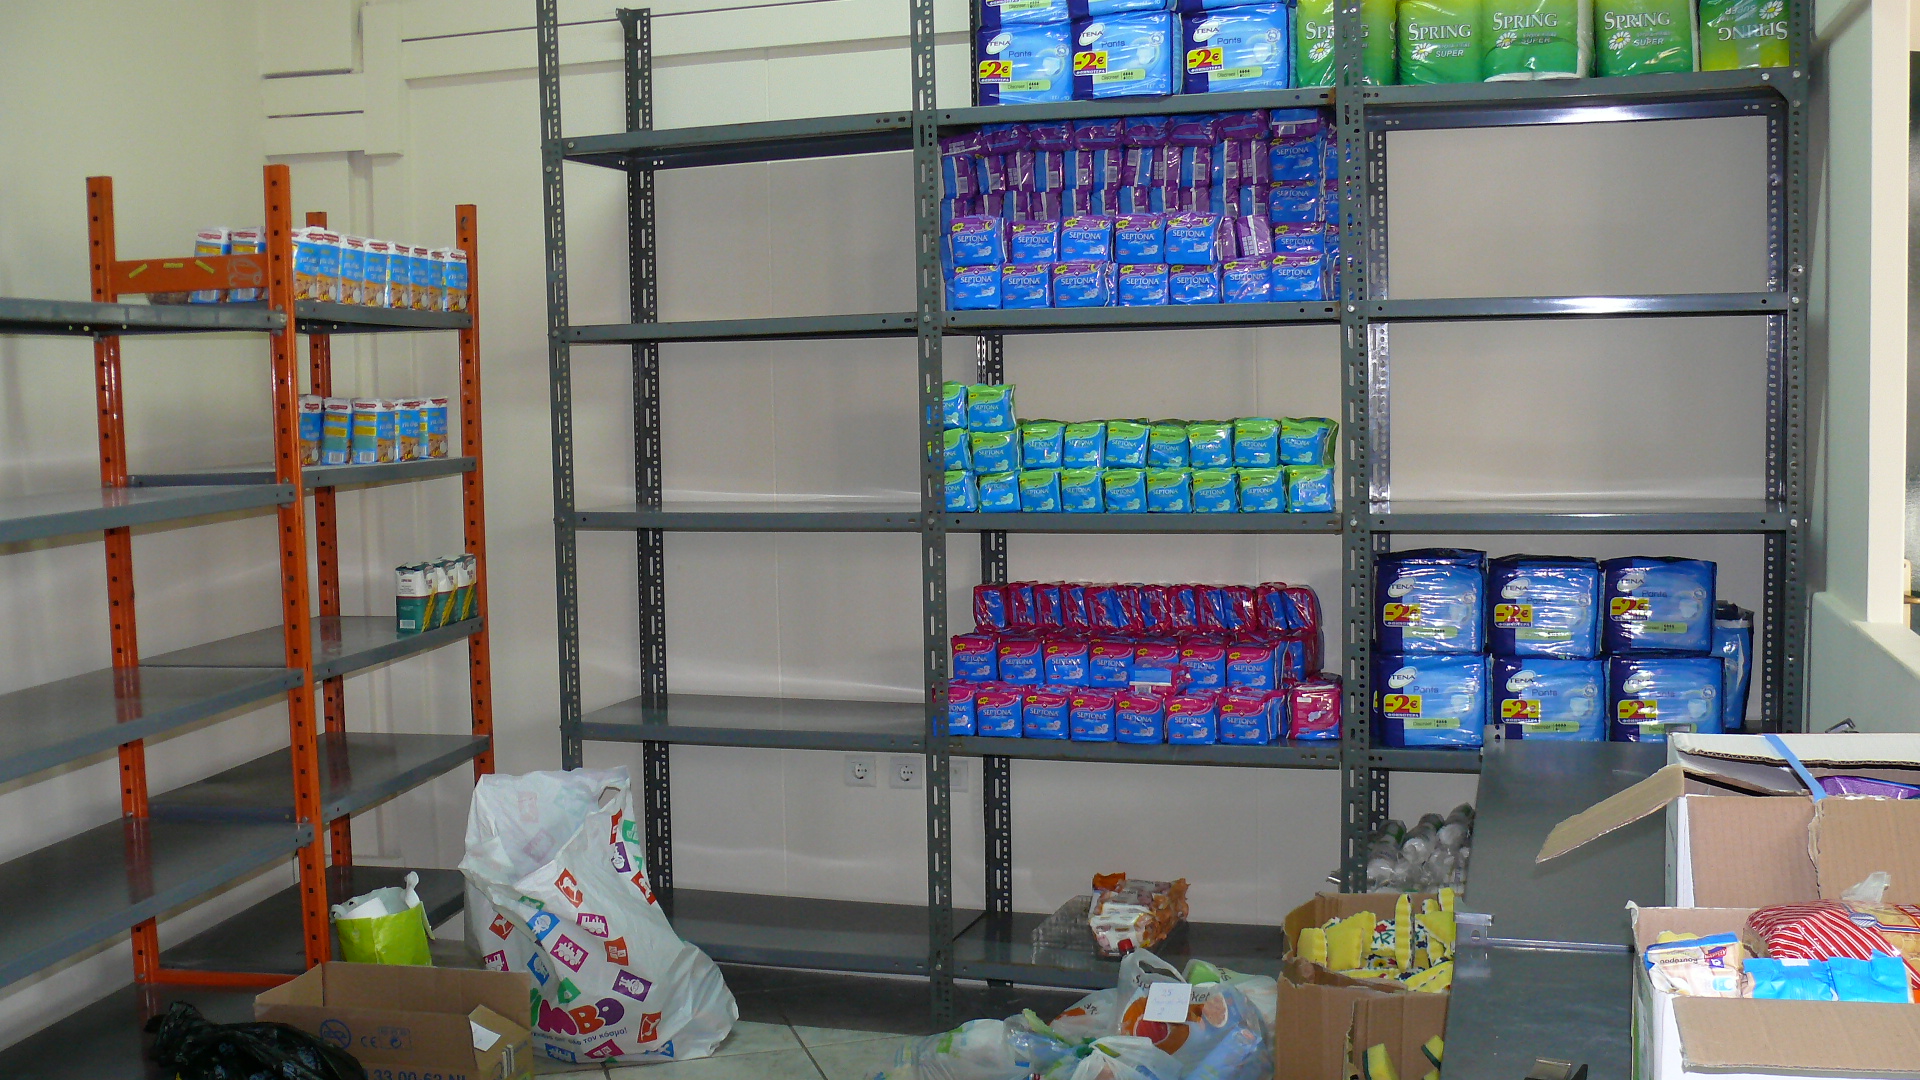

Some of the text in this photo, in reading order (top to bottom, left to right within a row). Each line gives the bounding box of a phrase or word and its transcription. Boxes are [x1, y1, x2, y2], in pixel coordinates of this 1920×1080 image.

[1492, 12, 1558, 31] SPRING
[1604, 11, 1670, 30] SPRING
[1408, 22, 1472, 41] SPRING
[1718, 20, 1788, 41] SPRING
[1101, 40, 1126, 48] Pants
[1217, 37, 1242, 45] Pants
[1633, 38, 1664, 47] SUPER
[1008, 50, 1032, 58] Pants
[1436, 49, 1464, 58] SUPER
[1276, 147, 1309, 156] SEPTONA
[1276, 189, 1309, 198] SEPTONA
[1069, 231, 1102, 240] SEPTONA
[1121, 232, 1155, 240] SEPTONA
[1172, 229, 1206, 238] SEPTONA
[957, 234, 989, 243] SEPTONA
[1018, 236, 1050, 244] SEPTONA
[1278, 268, 1312, 276] SEPTONA
[960, 275, 992, 284] SEPTONA
[1008, 277, 1041, 285] SEPTONA
[1061, 277, 1094, 285] SEPTONA
[1126, 277, 1160, 285] SEPTONA
[1176, 276, 1210, 284] SEPTONA
[1641, 589, 1668, 598] Pants
[1233, 664, 1264, 672] SEPTONA
[1413, 685, 1439, 694] Pants
[1531, 689, 1558, 697] Pants
[1029, 708, 1059, 717] SEPTONA
[1226, 716, 1257, 725] SEPTONA
[599, 1027, 628, 1039] κόσμο!
